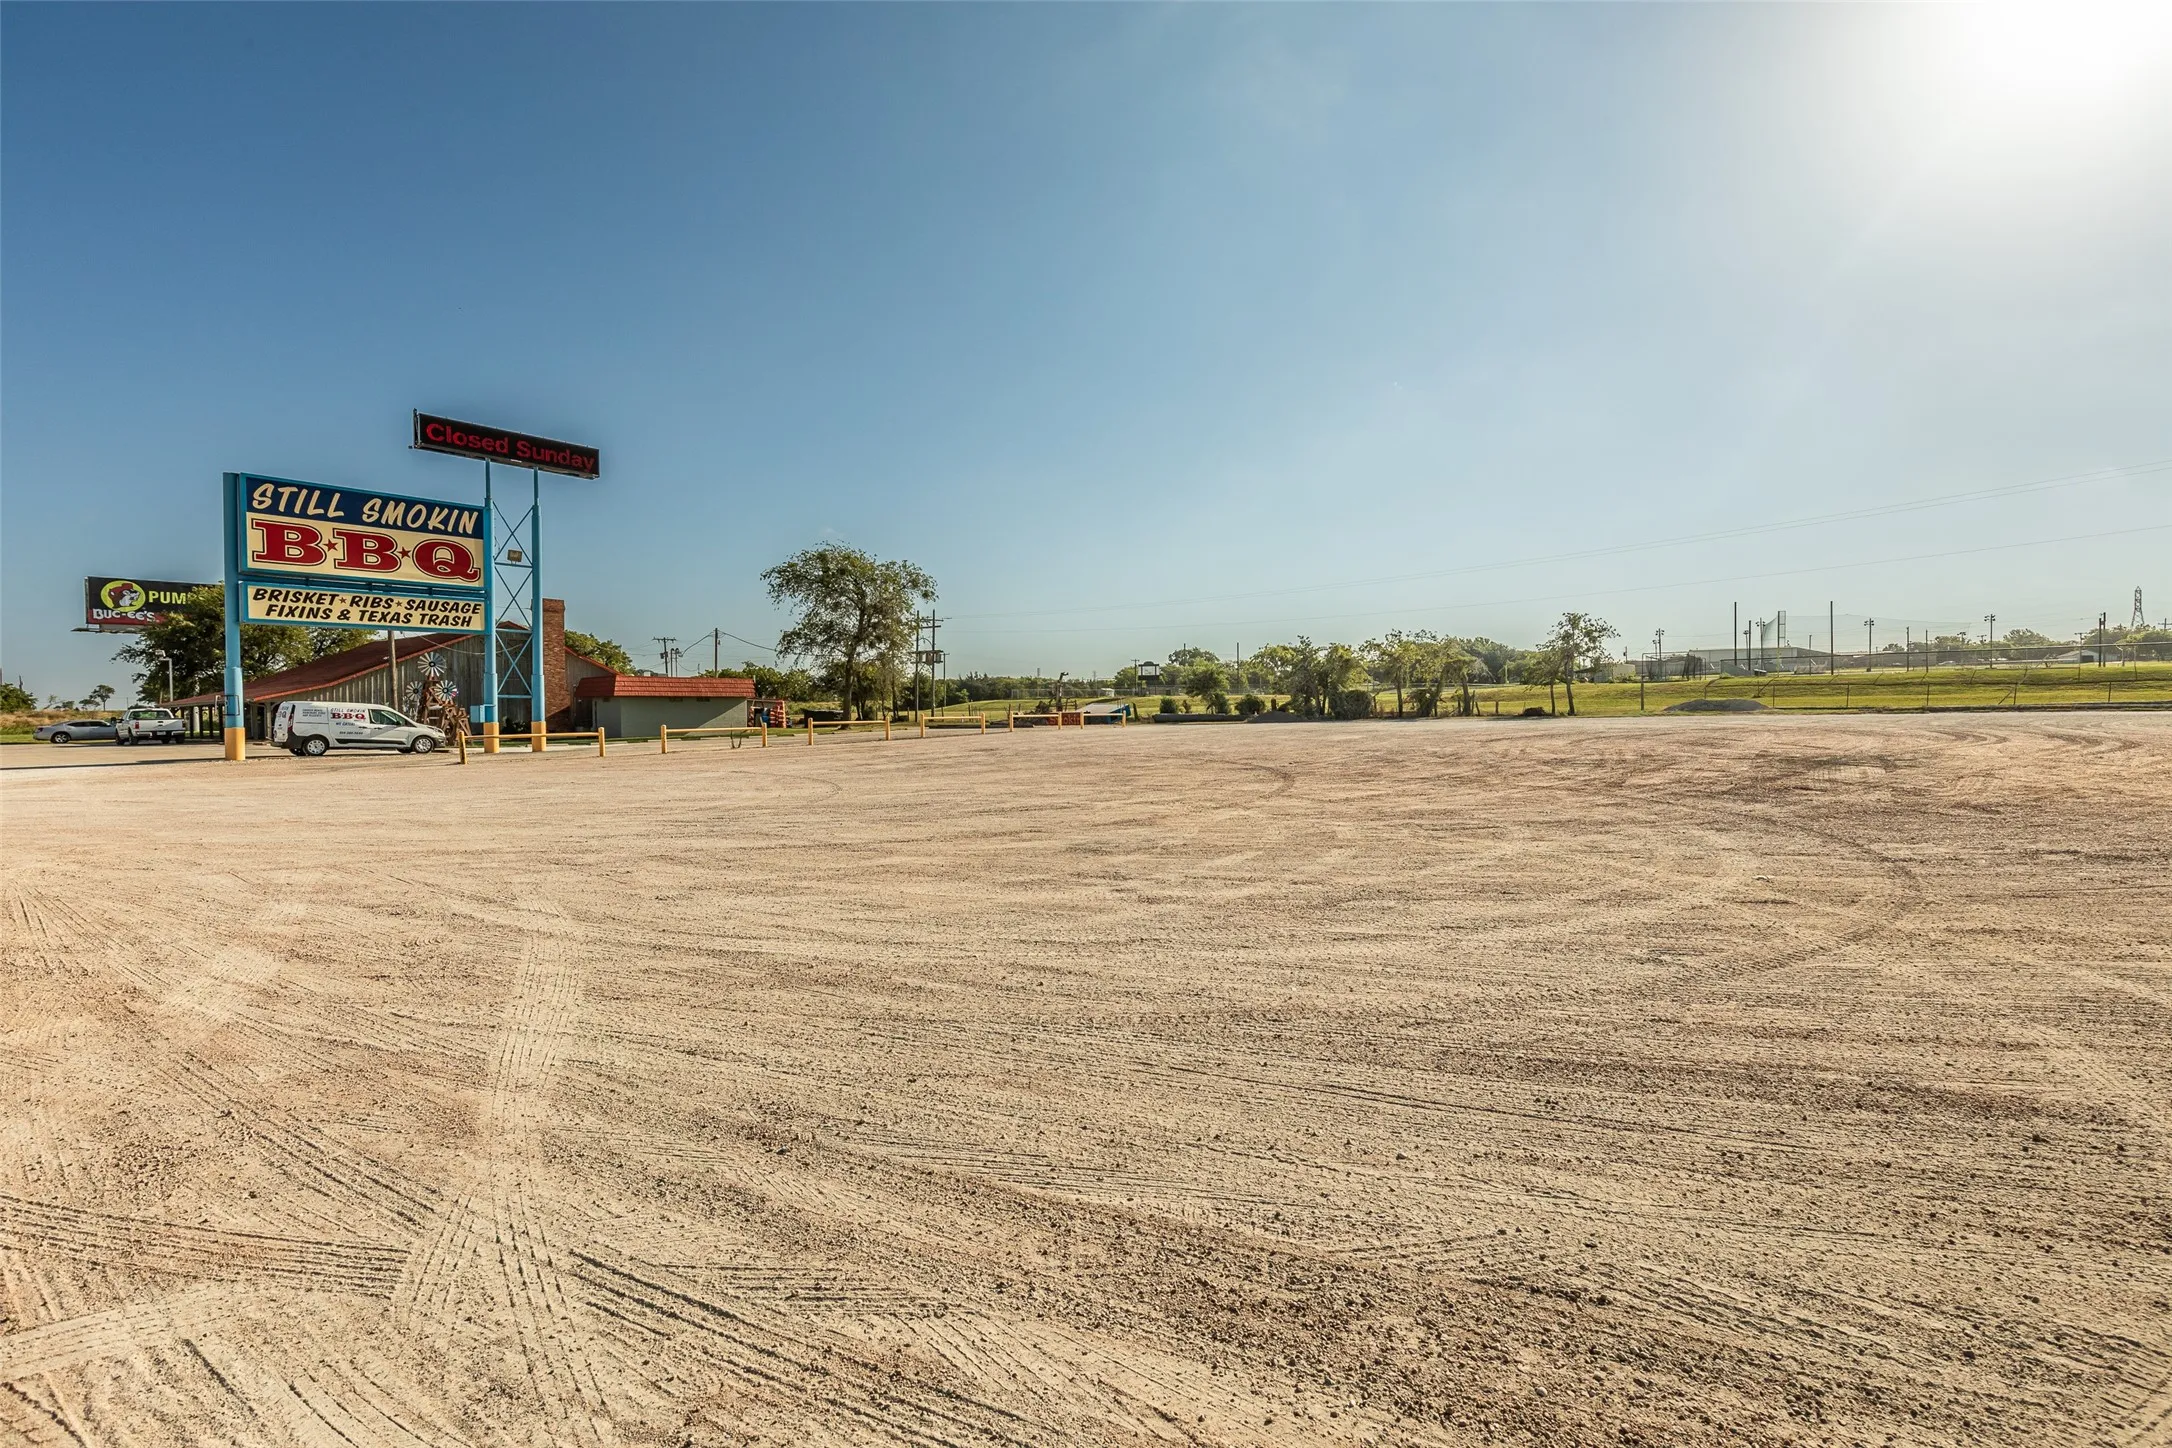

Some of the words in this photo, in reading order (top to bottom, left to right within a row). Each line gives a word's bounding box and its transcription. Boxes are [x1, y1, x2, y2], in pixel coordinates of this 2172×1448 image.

[426, 423, 509, 454] Closed
[516, 440, 595, 472] Sunday
[252, 482, 345, 518] STILL
[362, 497, 479, 534] SMOKIN
[148, 590, 196, 605] PUM
[252, 588, 339, 605] BRISKET
[349, 595, 394, 609] RIBS
[404, 598, 481, 615] SAUSAGE
[265, 604, 333, 620] FIXINS
[337, 608, 351, 621] &
[359, 609, 413, 624] TEXAS
[419, 613, 473, 628] TRASH
